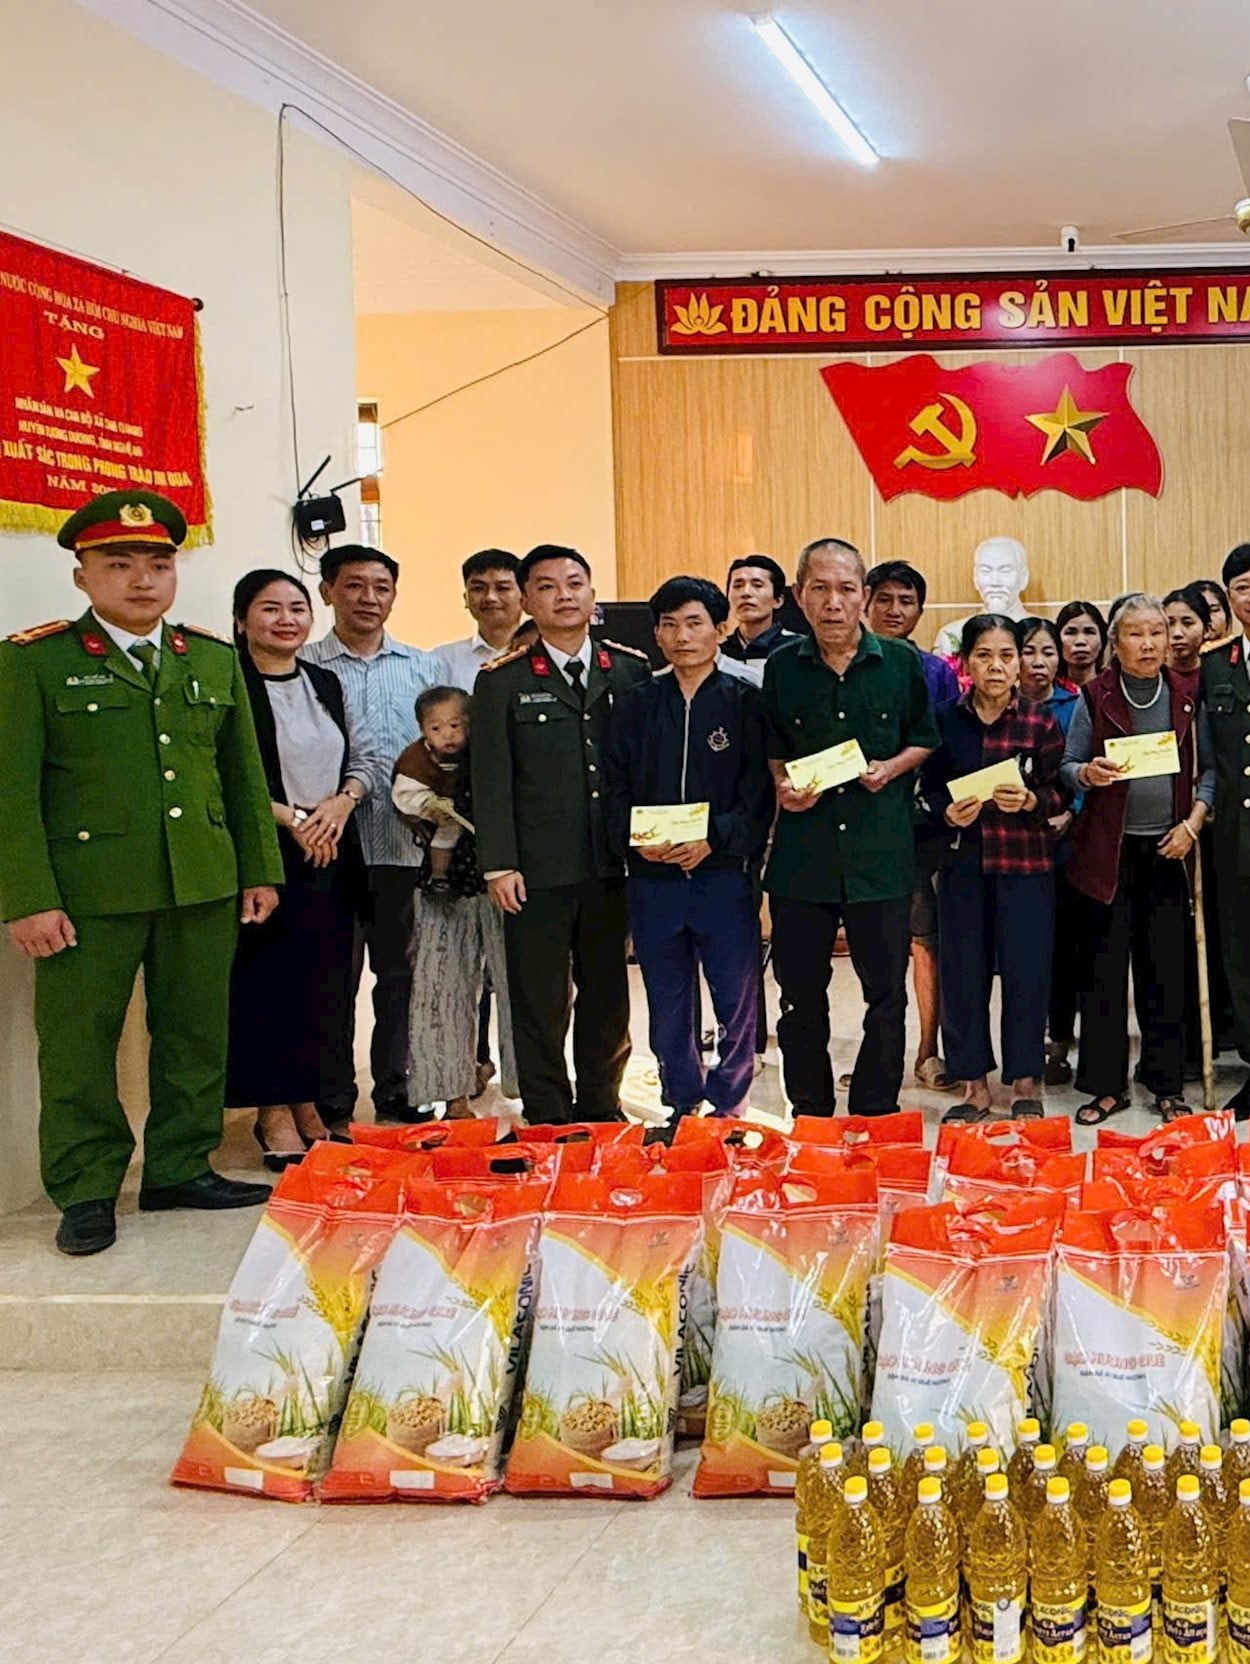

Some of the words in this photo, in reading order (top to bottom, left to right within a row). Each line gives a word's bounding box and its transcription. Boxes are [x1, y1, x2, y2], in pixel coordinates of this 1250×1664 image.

[730, 285, 846, 334] ĐẢNG
[864, 284, 981, 340] CỘNG
[999, 279, 1088, 329] SẢN
[1100, 279, 1194, 333] VIỆT
[46, 473, 87, 492] NĂM
